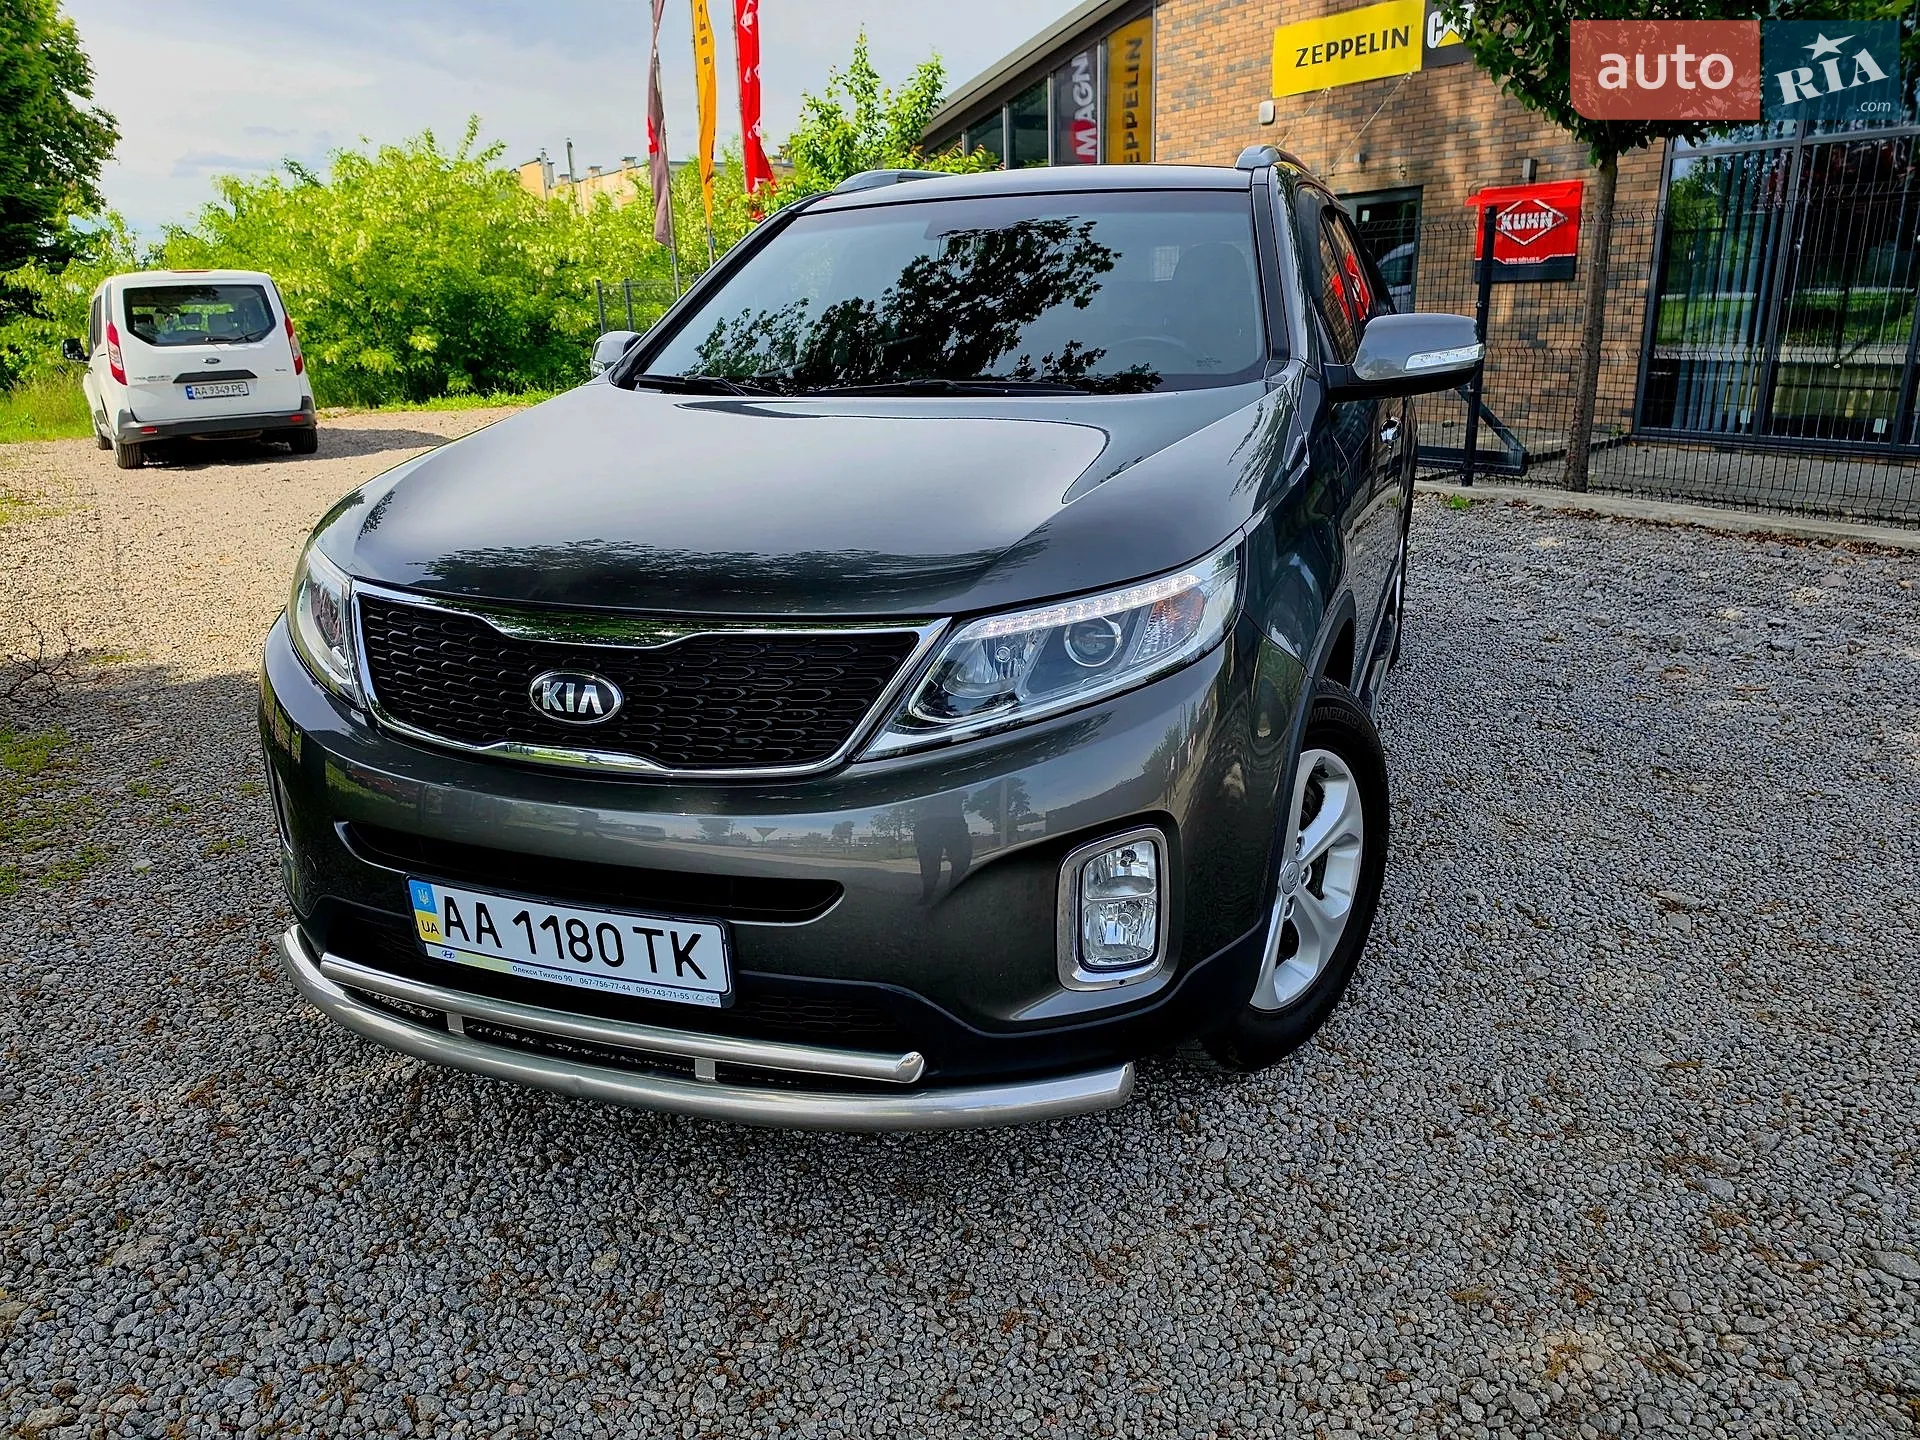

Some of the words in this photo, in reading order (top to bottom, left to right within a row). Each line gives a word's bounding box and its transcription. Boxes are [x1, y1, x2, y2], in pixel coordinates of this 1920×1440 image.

[1295, 26, 1410, 68] ZEPPELIN
[1122, 38, 1143, 163] EPPELIN
[1500, 211, 1554, 232] KUHN
[194, 386, 208, 396] AA
[209, 385, 231, 395] 9349
[231, 384, 246, 393] PE
[542, 681, 604, 715] KIA
[421, 921, 440, 935] UA
[443, 895, 503, 949] AA
[512, 909, 625, 968] 1180
[632, 925, 708, 980] TK
